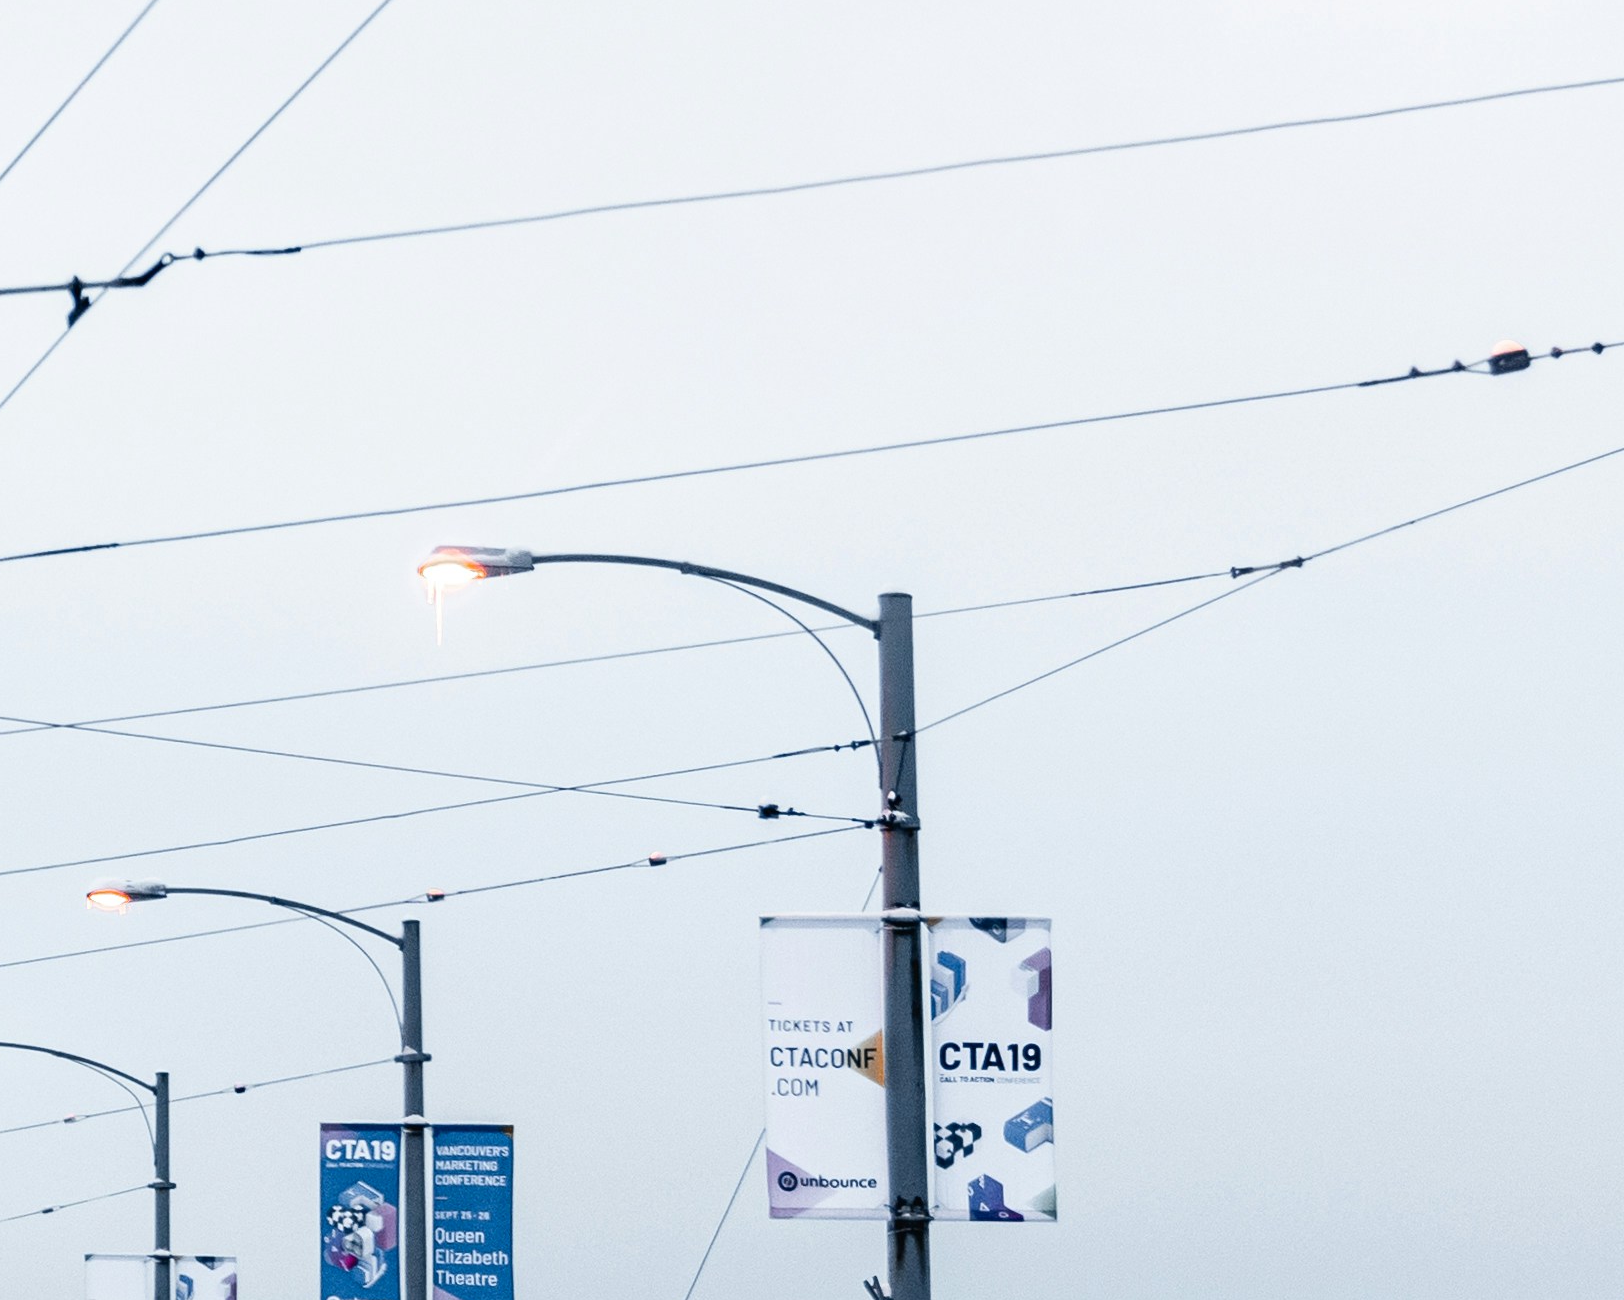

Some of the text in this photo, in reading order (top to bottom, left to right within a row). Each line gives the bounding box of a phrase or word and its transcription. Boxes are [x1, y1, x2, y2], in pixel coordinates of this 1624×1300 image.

[768, 1019, 853, 1033] TICKETS AT
[770, 1047, 877, 1069] CTACONF
[939, 1042, 1042, 1072] CTA19
[771, 1078, 819, 1097] .COM
[325, 1139, 396, 1161] CTA19
[435, 1160, 498, 1171] MARKETING
[435, 1174, 507, 1187] CONFERENCE
[800, 1175, 877, 1189] unbounce
[434, 1211, 459, 1220] SEPT
[435, 1227, 485, 1245] Queen
[435, 1249, 509, 1265] Elizabeth
[436, 1270, 498, 1287] Theatre
